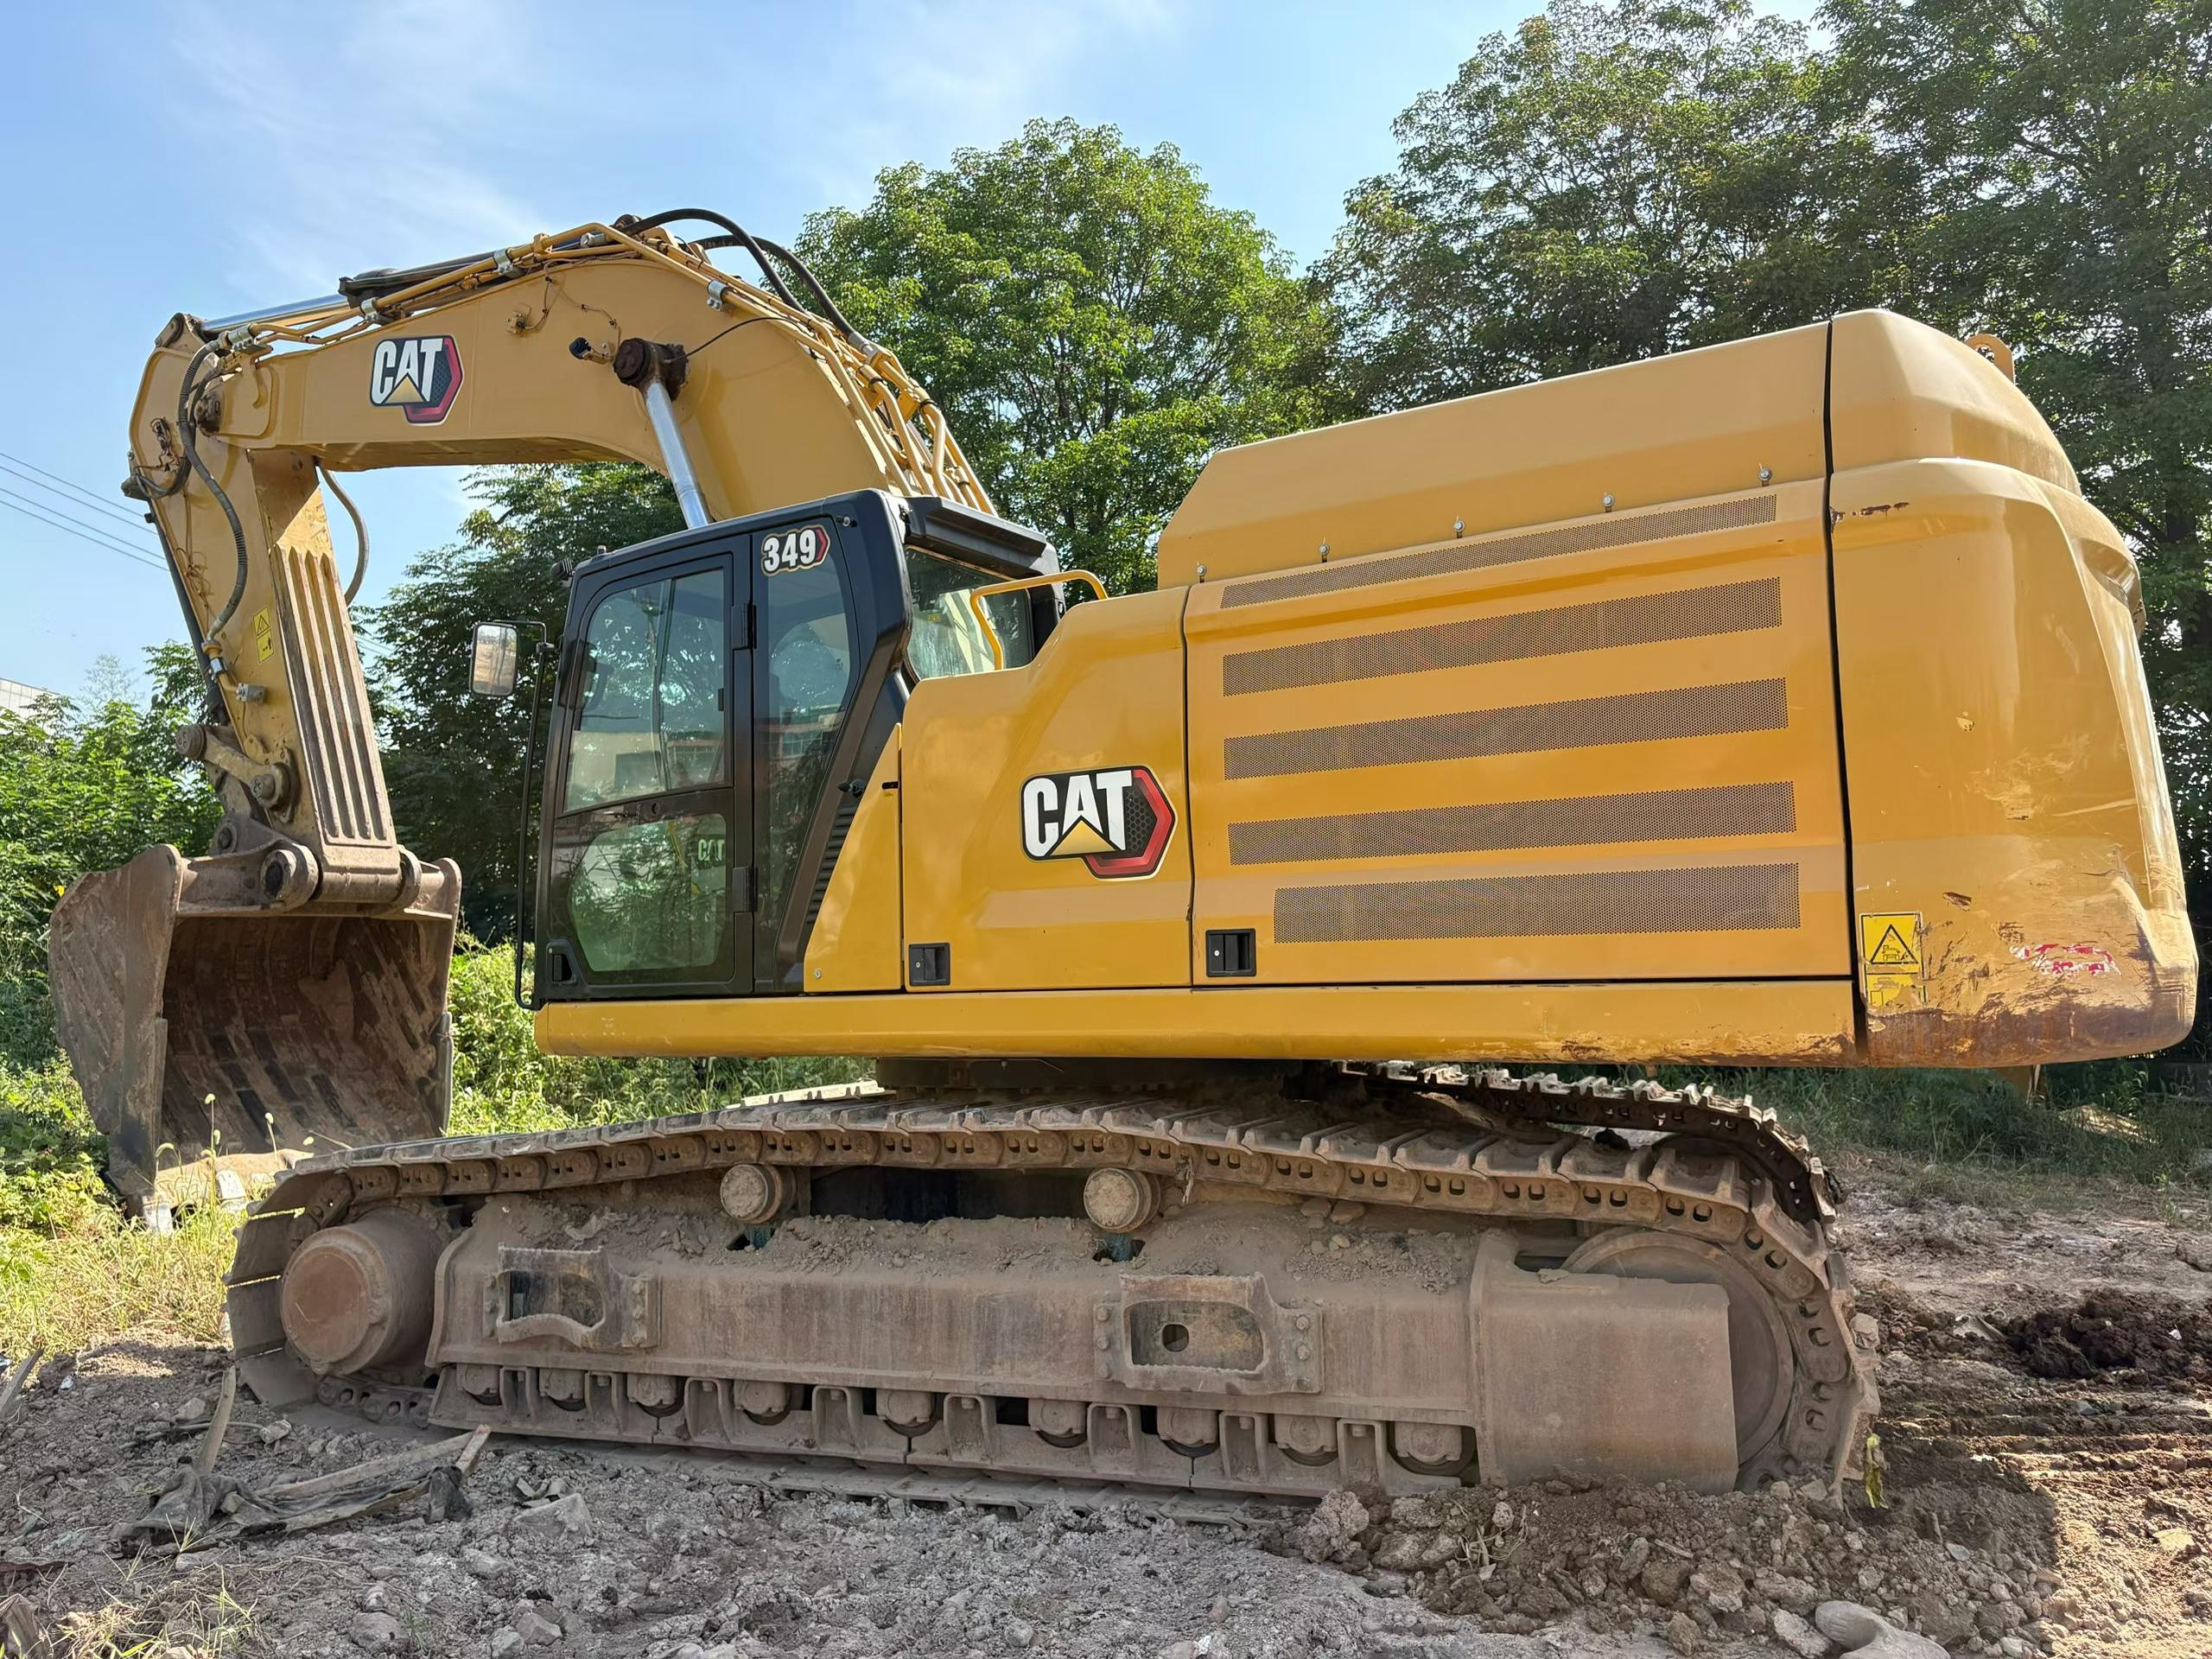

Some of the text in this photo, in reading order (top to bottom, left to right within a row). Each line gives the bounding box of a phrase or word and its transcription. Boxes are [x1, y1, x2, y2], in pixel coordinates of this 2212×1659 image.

[371, 338, 443, 404] CAT
[764, 529, 817, 572] 349
[1023, 769, 1133, 857] CAT
[697, 838, 726, 861] CAT
